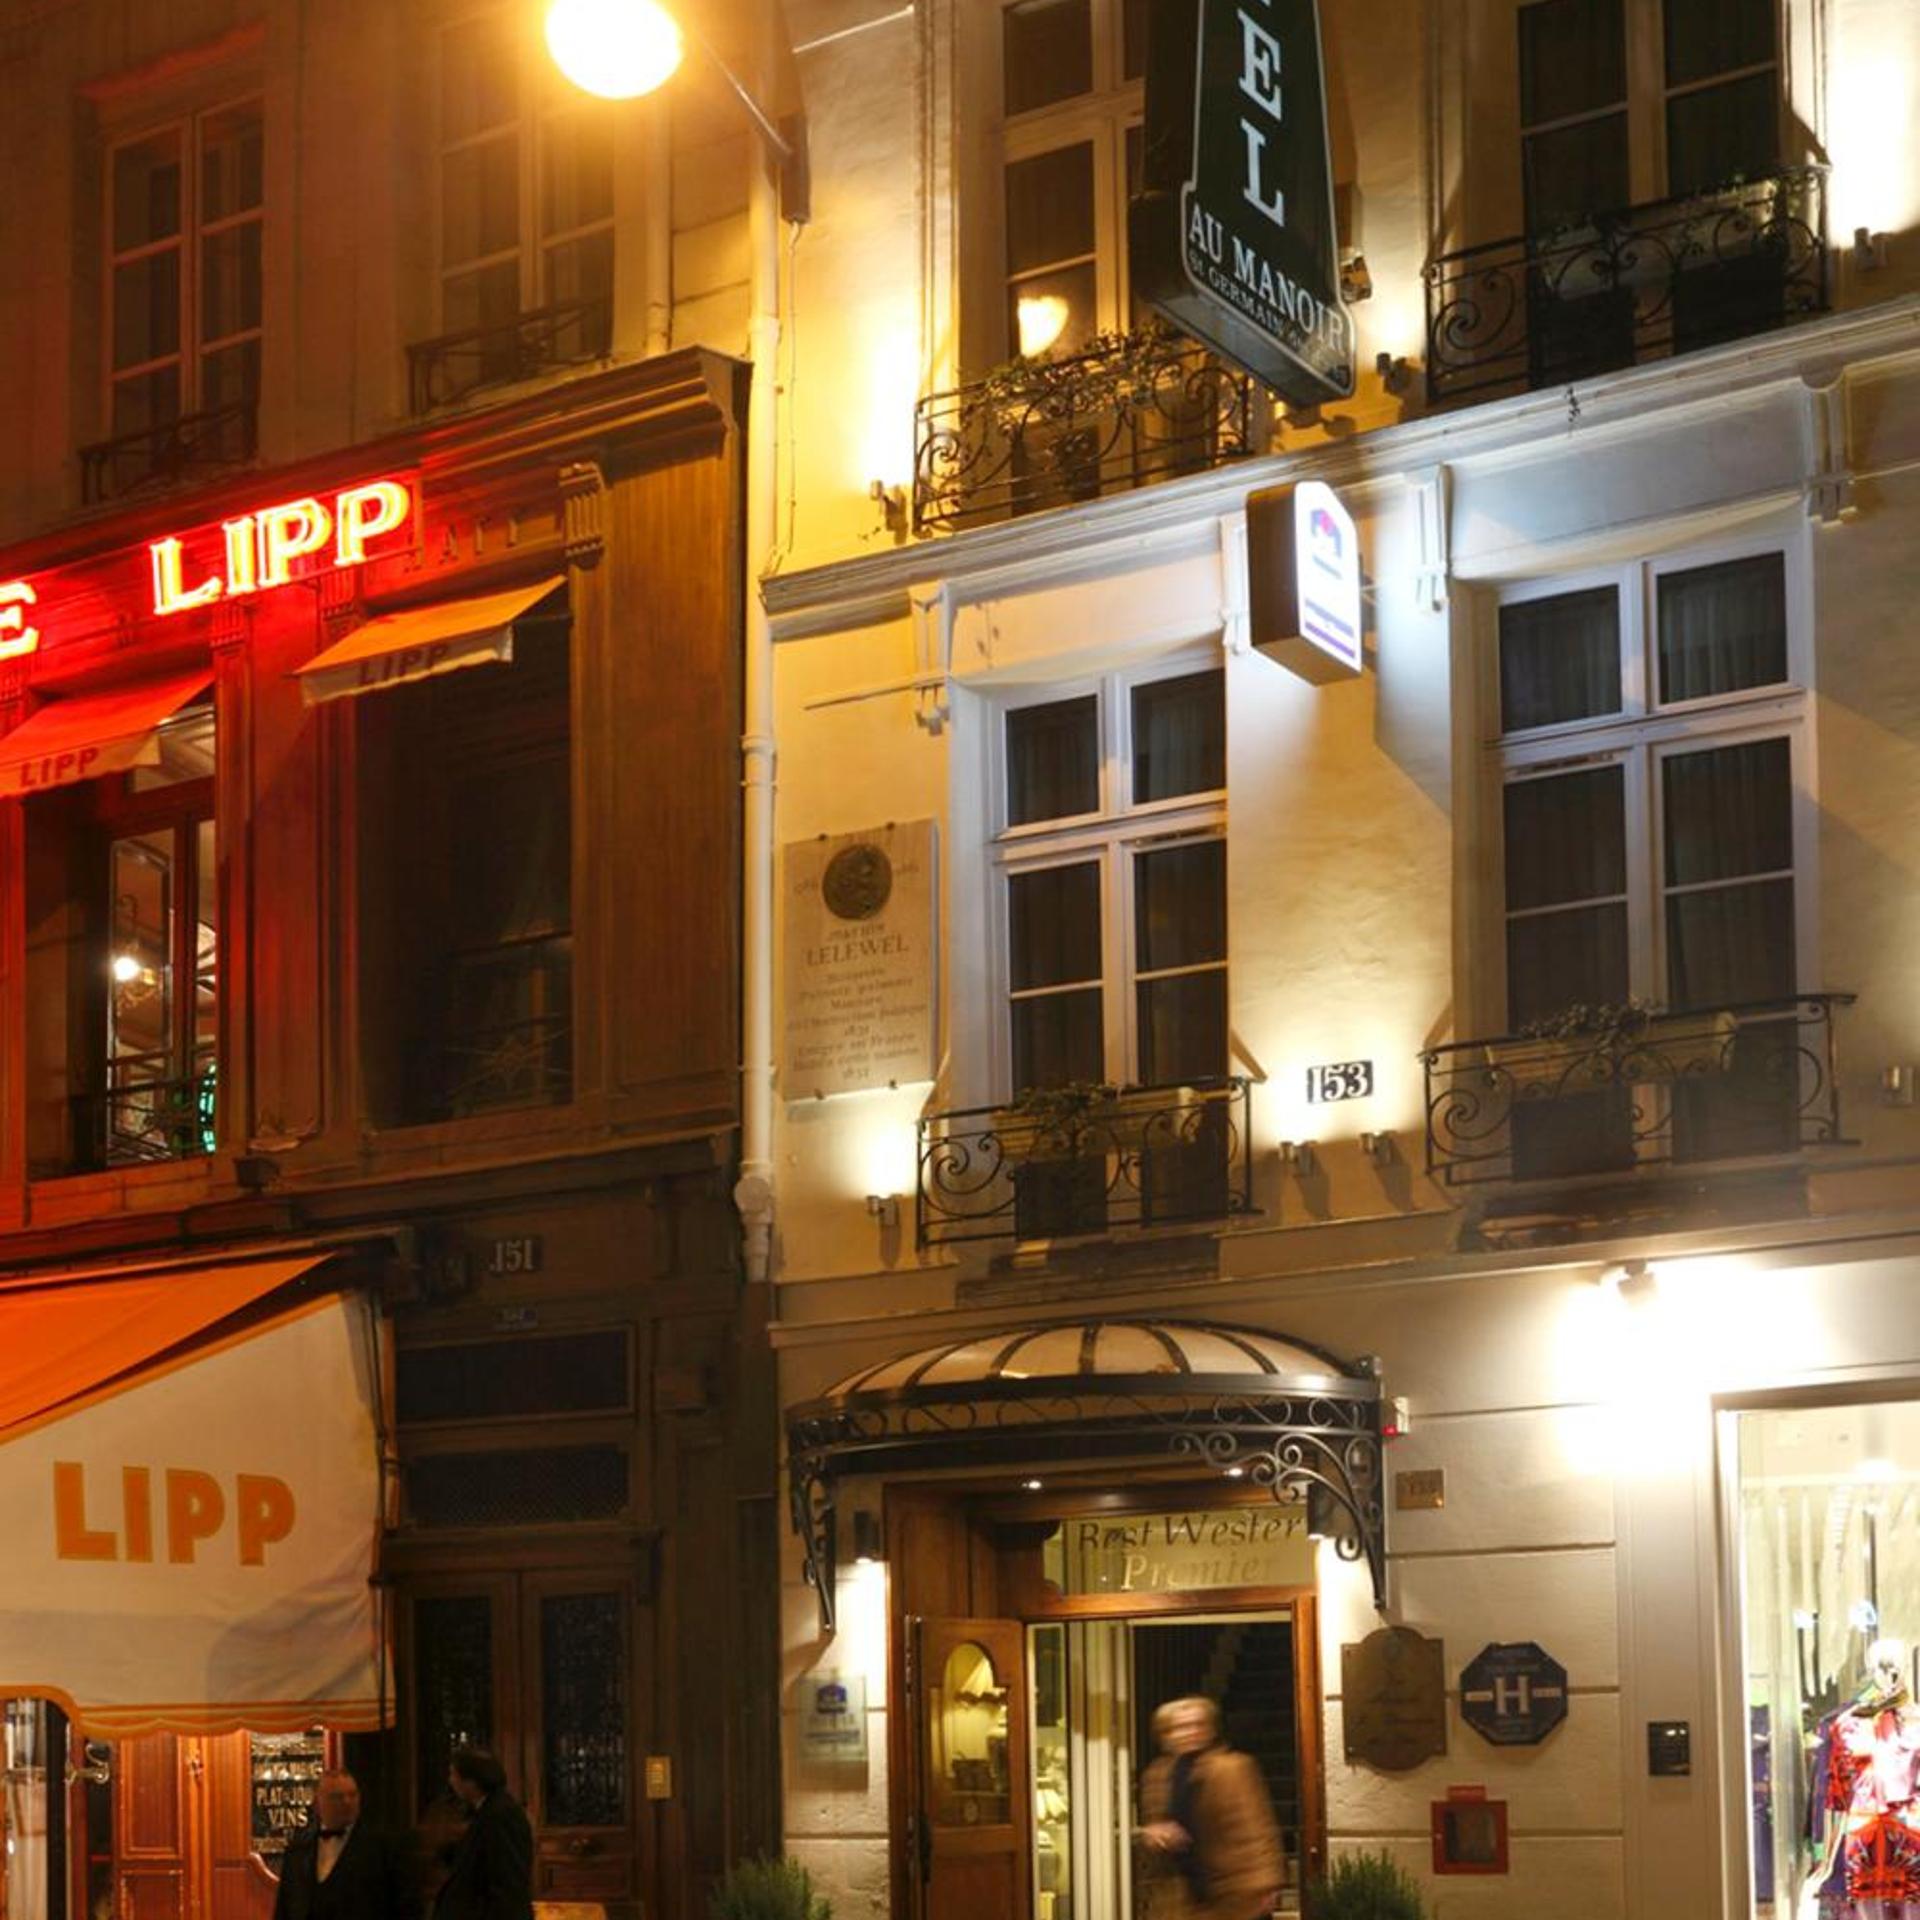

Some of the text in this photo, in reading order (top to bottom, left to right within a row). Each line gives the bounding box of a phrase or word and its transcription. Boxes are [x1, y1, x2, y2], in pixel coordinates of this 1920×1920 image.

[1236, 0, 1285, 228] EL
[1189, 203, 1224, 264] AU
[1232, 235, 1346, 357] MANOIR
[149, 481, 411, 616] LIPP
[356, 643, 452, 687] LIPP
[20, 746, 99, 787] LIPP
[805, 933, 910, 966] LELEWEL
[1310, 1061, 1370, 1101] 153
[489, 1239, 534, 1272] 151
[53, 1461, 296, 1567] LIPP
[1078, 1508, 1302, 1551] Best Wester
[1495, 1674, 1530, 1716] H
[267, 1806, 309, 1828] VINS
